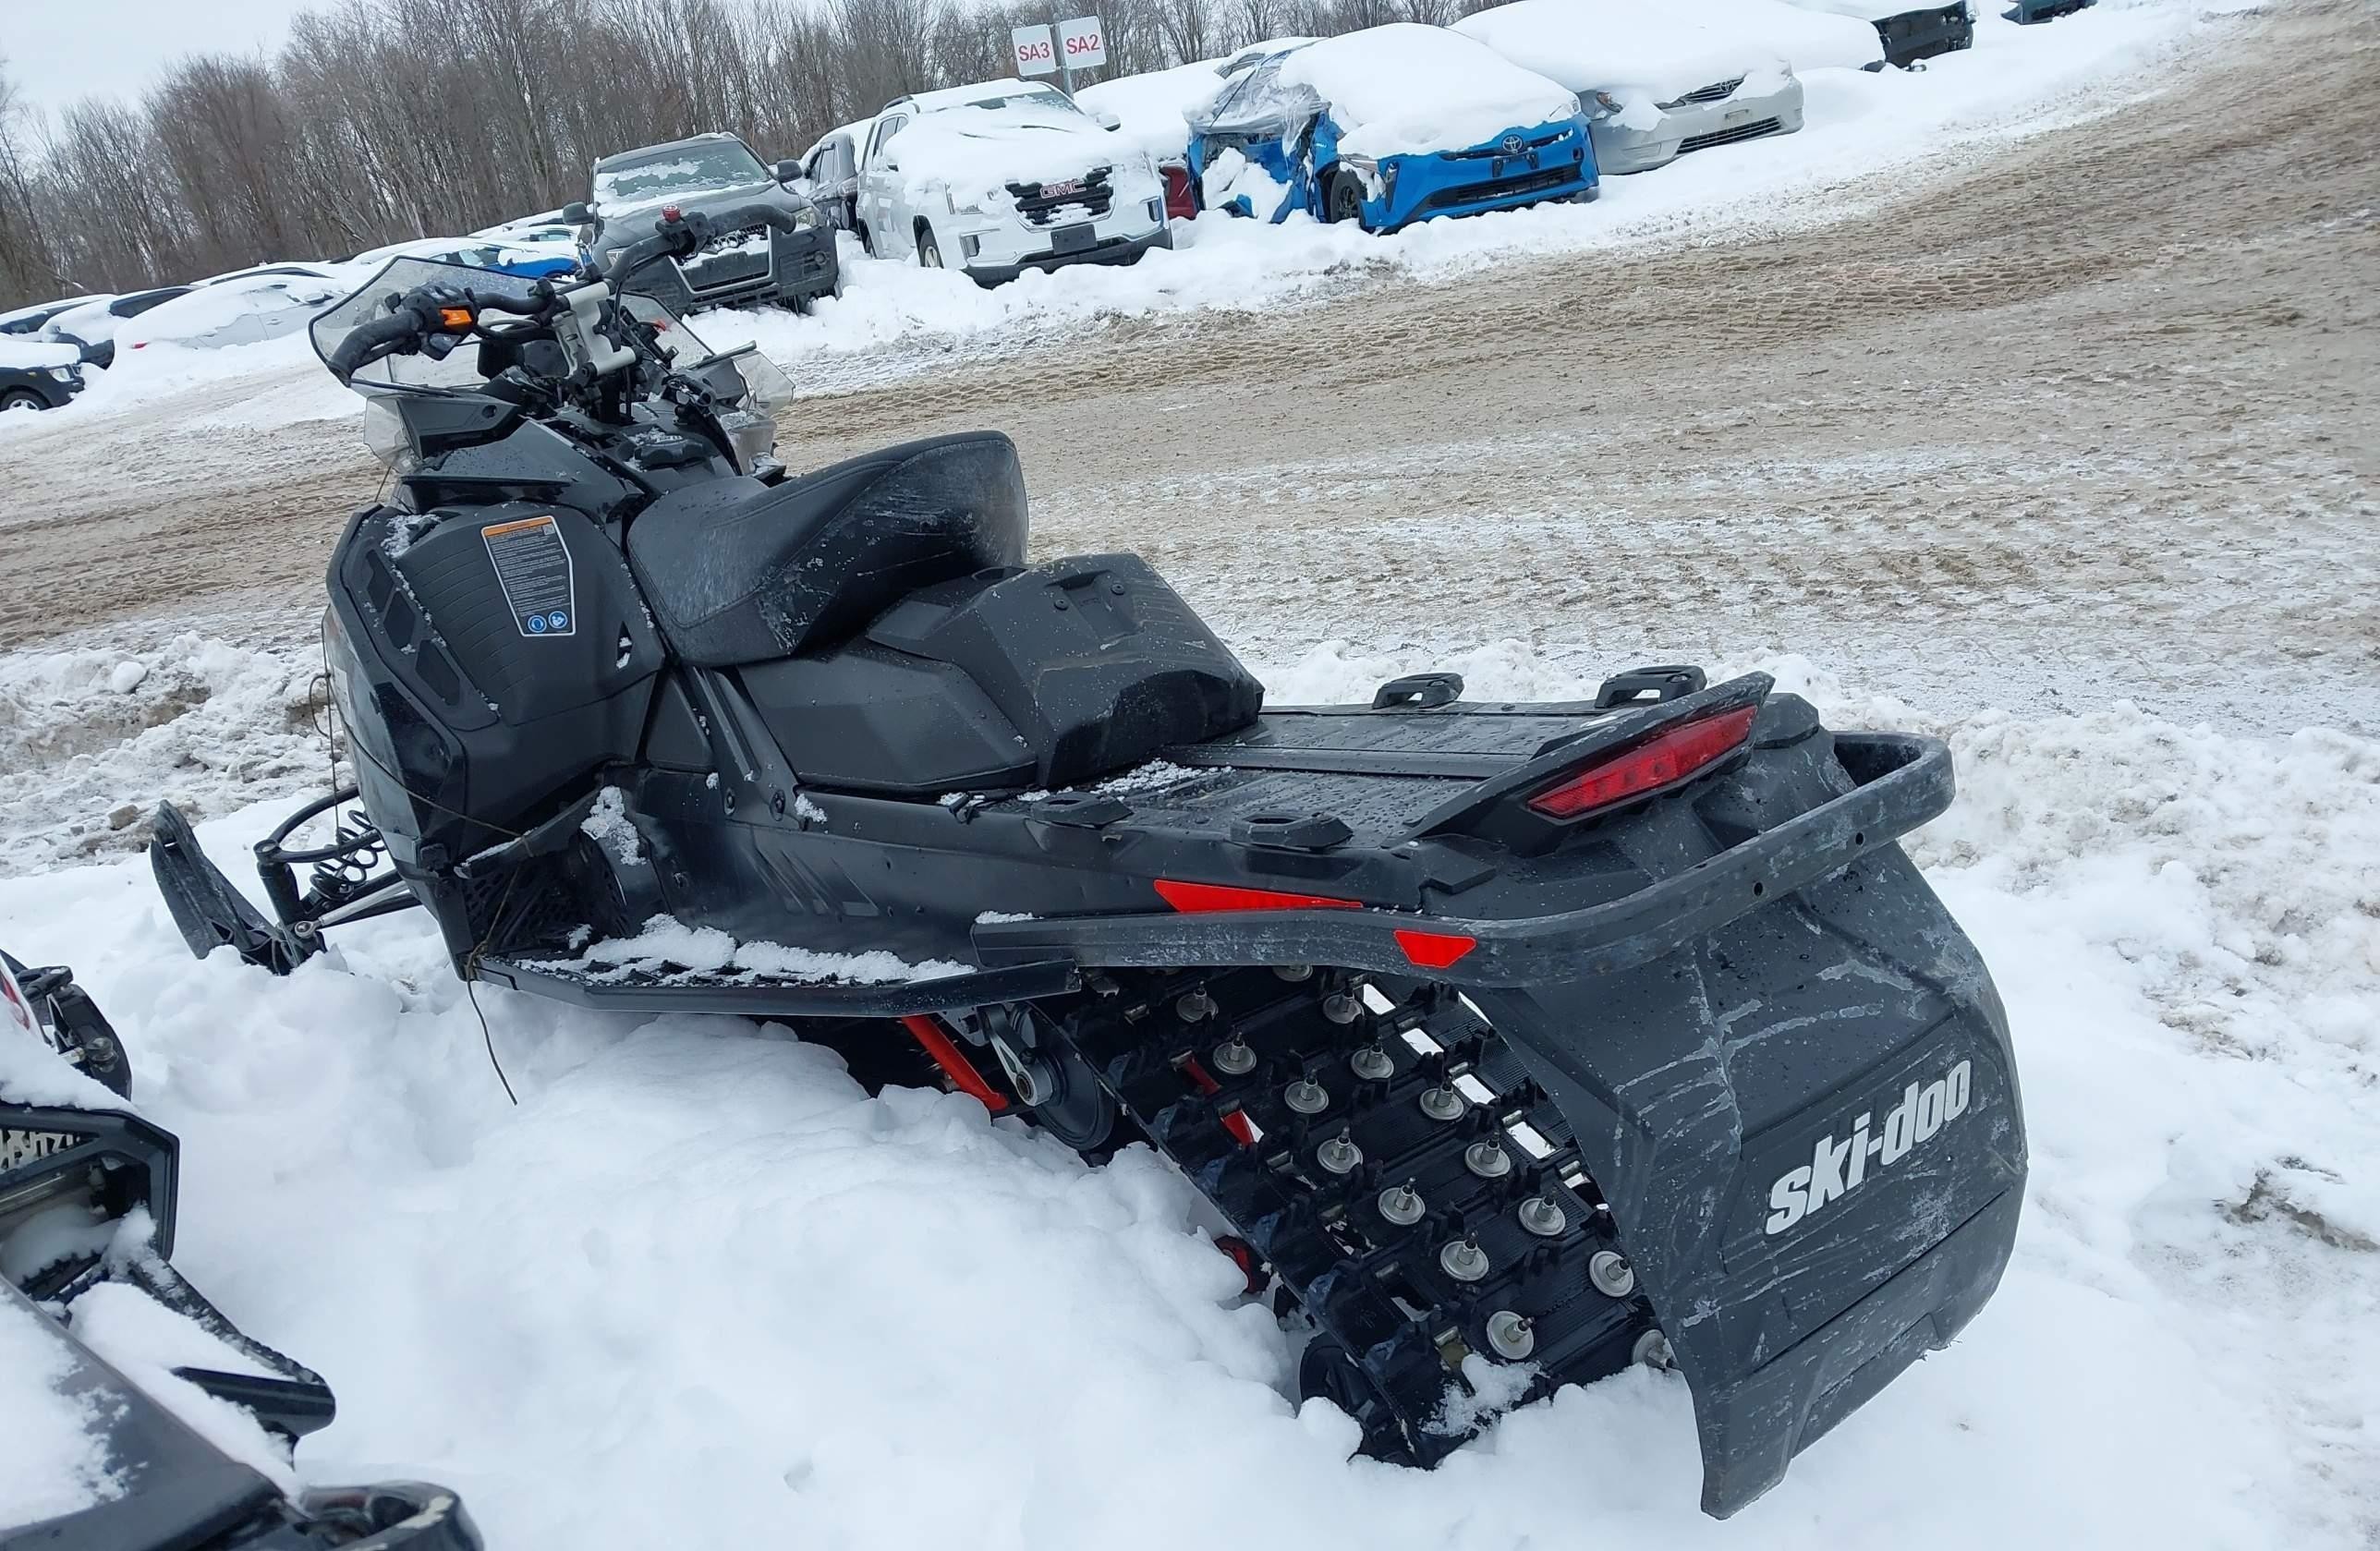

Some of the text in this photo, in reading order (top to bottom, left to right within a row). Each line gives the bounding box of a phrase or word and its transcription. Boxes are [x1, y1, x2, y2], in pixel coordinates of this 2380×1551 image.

[1018, 42, 1050, 62] SA3
[1065, 34, 1100, 55] SA2
[1039, 179, 1087, 200] GMC
[1766, 1060, 1972, 1235] ski-doo
